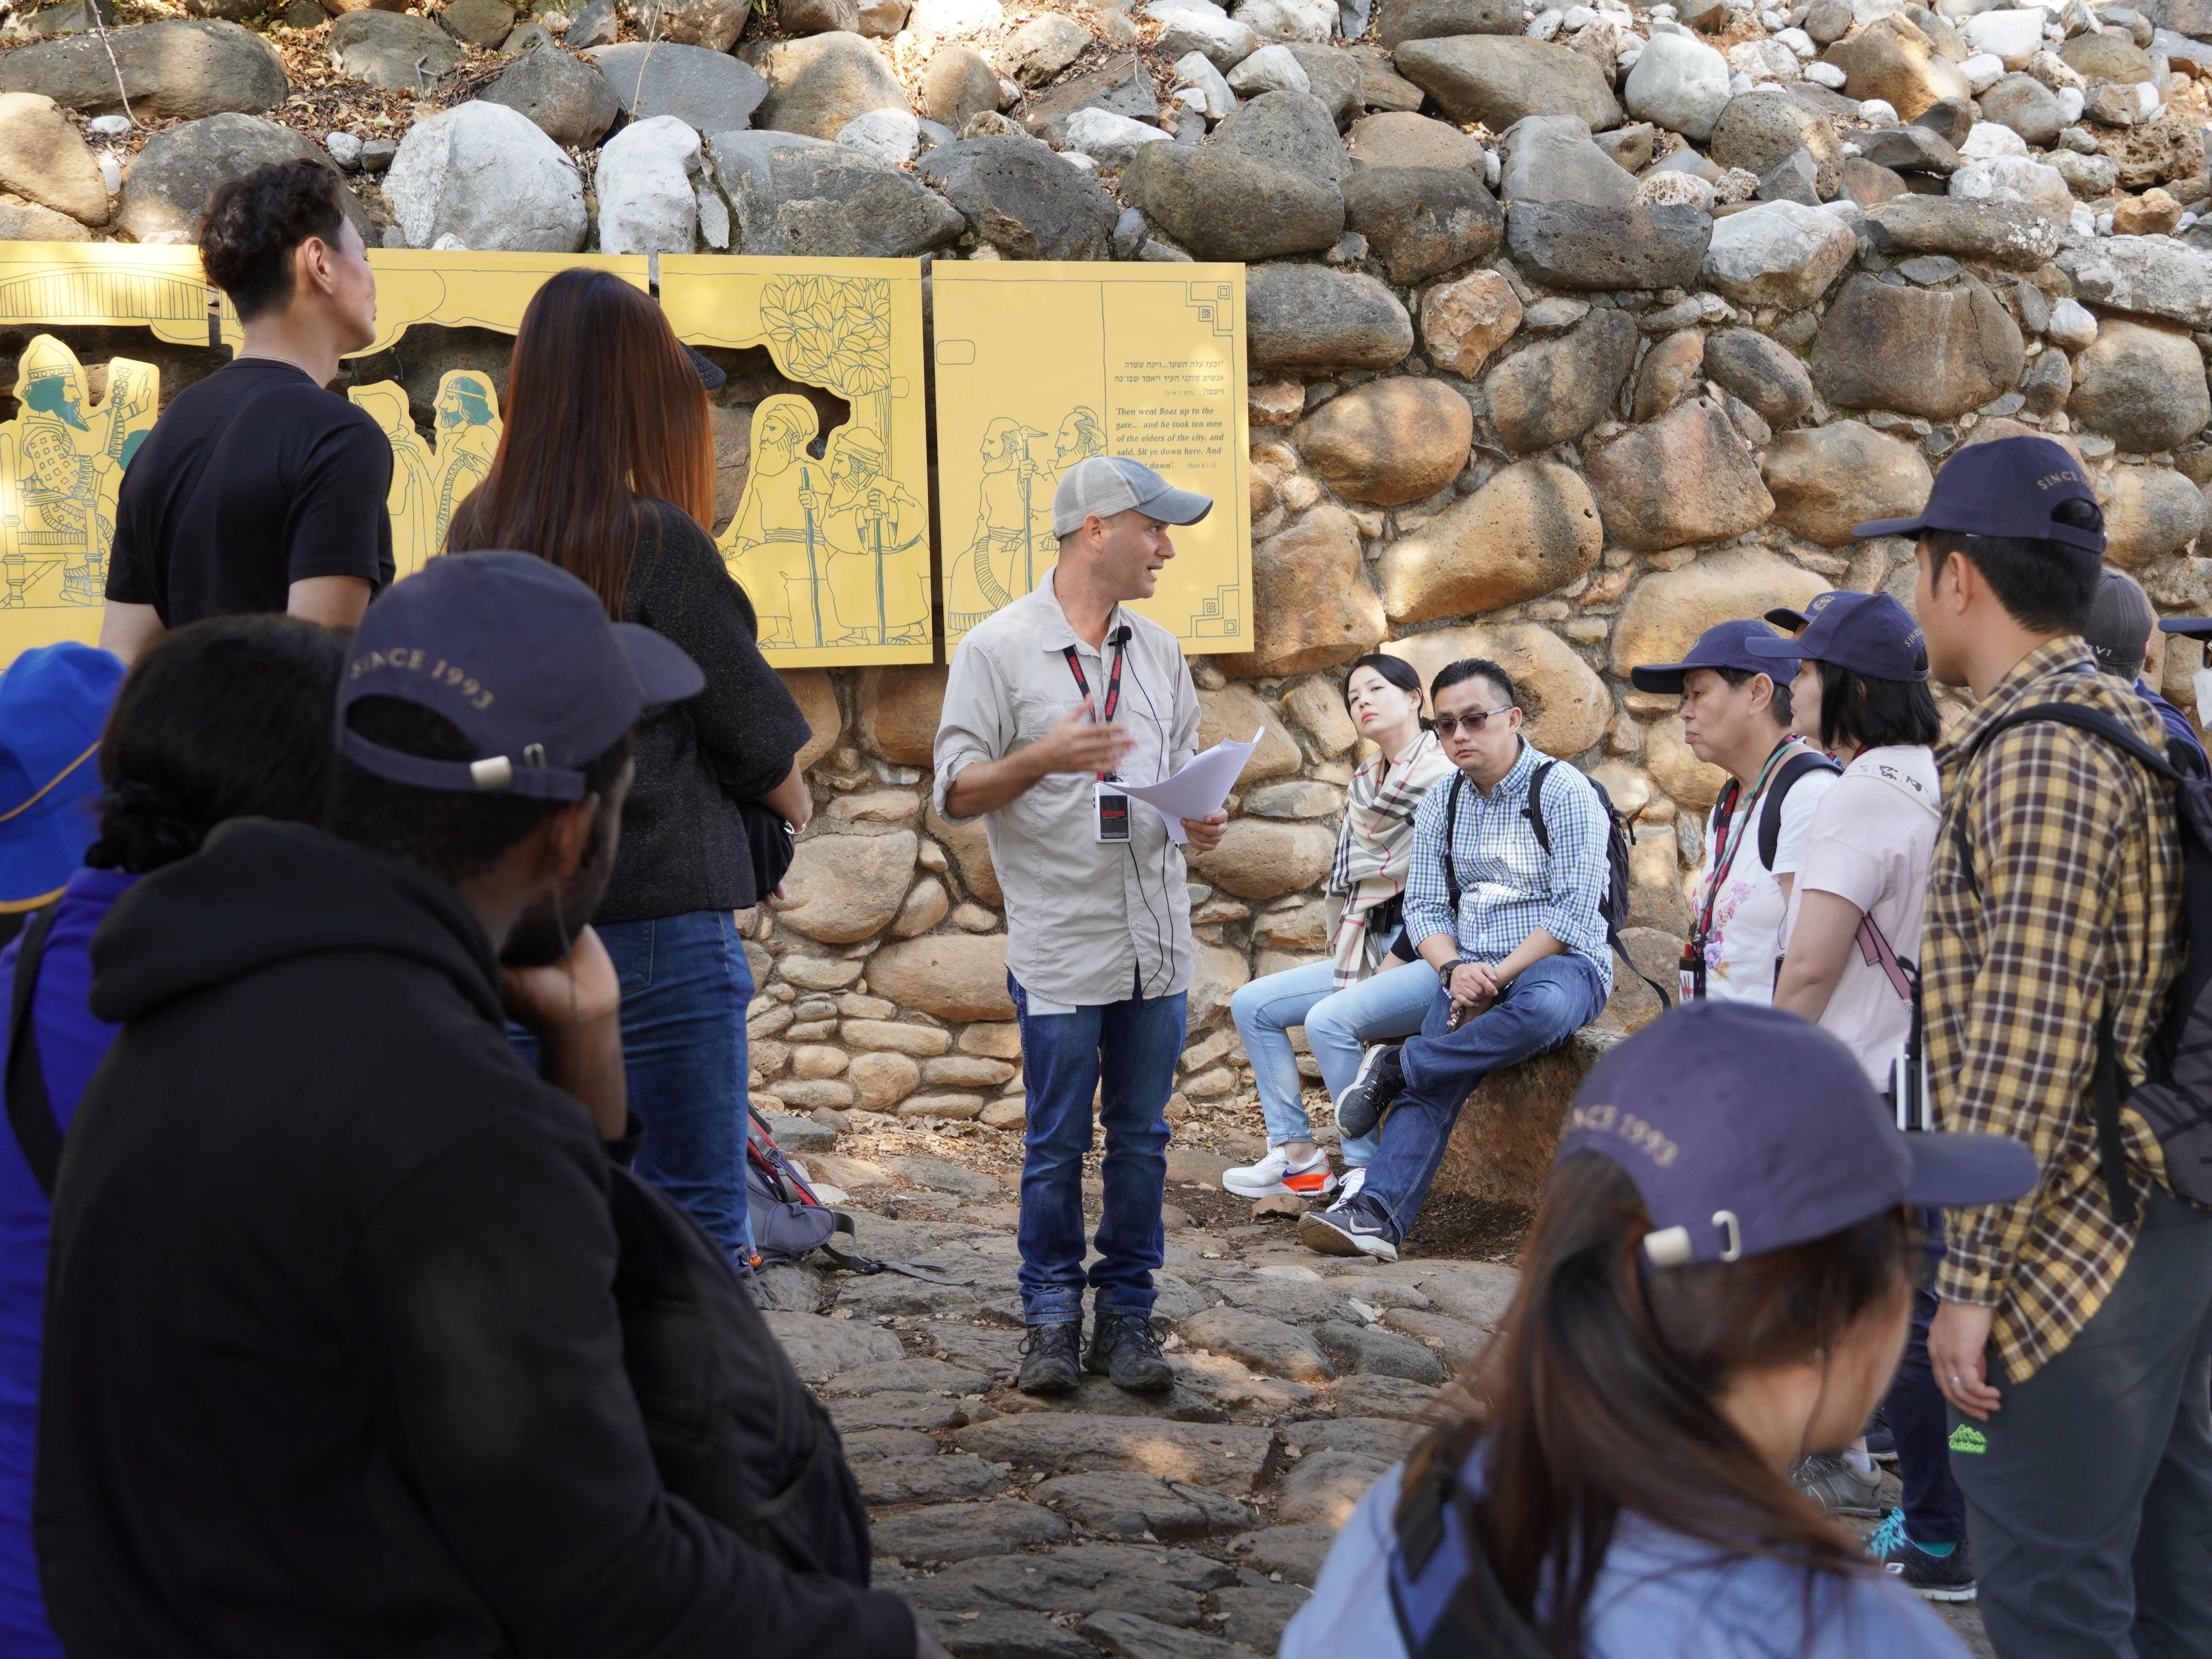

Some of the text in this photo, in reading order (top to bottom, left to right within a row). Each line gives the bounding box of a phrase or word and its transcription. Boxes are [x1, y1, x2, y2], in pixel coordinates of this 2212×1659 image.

[1190, 359, 1204, 369] עלה
[1182, 375, 1200, 383] מזקני
[1115, 422, 1139, 431] gate...
[1167, 434, 1176, 442] of
[1191, 433, 1207, 443] city,
[1209, 433, 1224, 441] and
[1117, 448, 1135, 457] said,
[2037, 471, 2079, 490] SINCE
[1904, 628, 1921, 647] SINCE
[350, 647, 494, 710] SINCE 1993
[1102, 810, 1126, 818] Whisper
[1949, 1438, 1987, 1454] Outdoor
